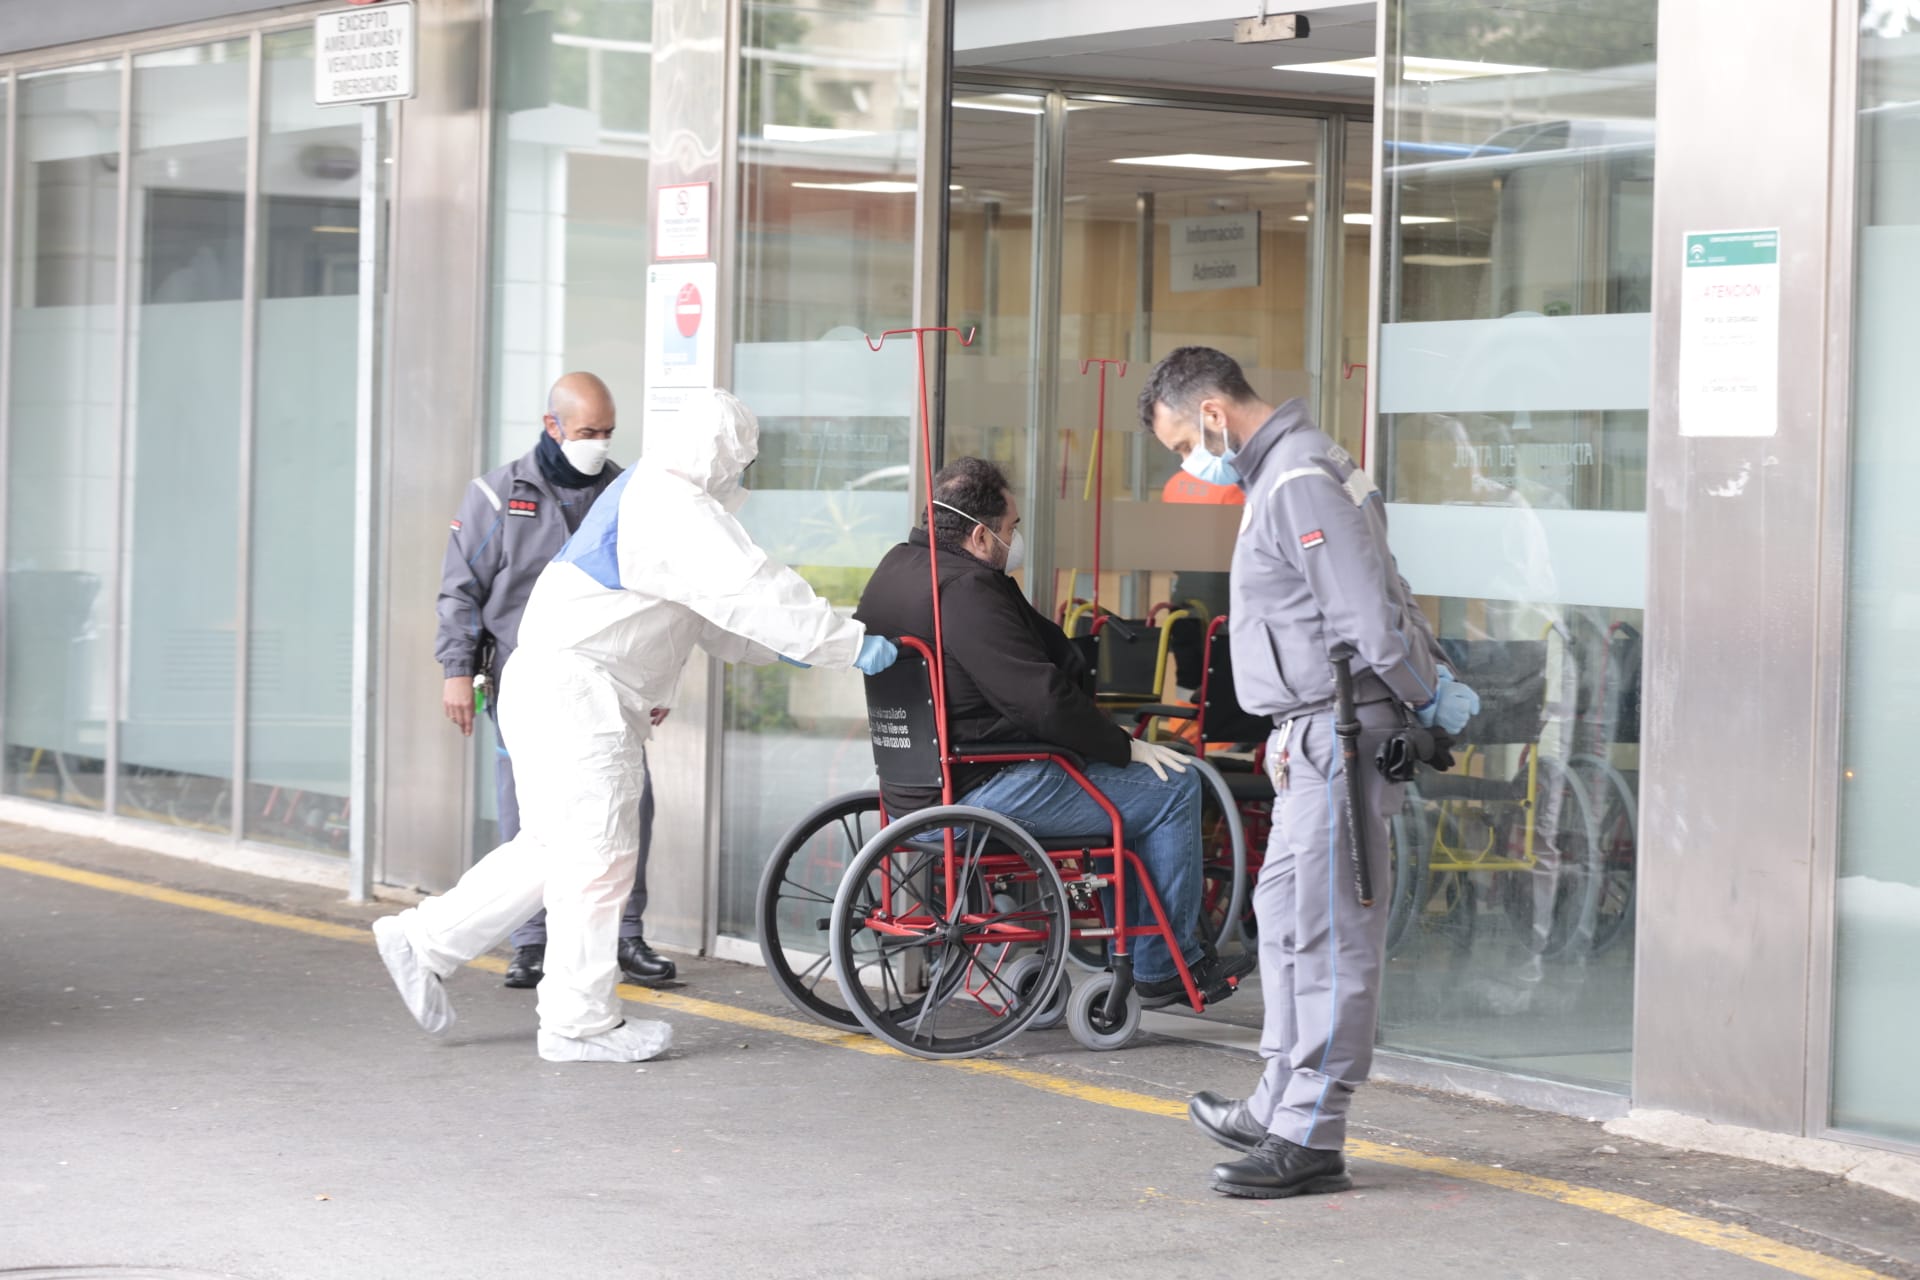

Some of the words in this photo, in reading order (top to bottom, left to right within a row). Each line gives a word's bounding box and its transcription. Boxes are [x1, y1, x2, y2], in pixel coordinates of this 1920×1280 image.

[338, 11, 389, 33] EXCEPTO
[324, 29, 394, 53] AMBULANCIAS
[385, 50, 399, 68] DE
[333, 75, 398, 97] EMERGENCIAS
[1185, 221, 1246, 244] Información
[1192, 259, 1237, 281] Admisión
[1453, 444, 1493, 469] JUNTA
[1500, 444, 1516, 467] DE
